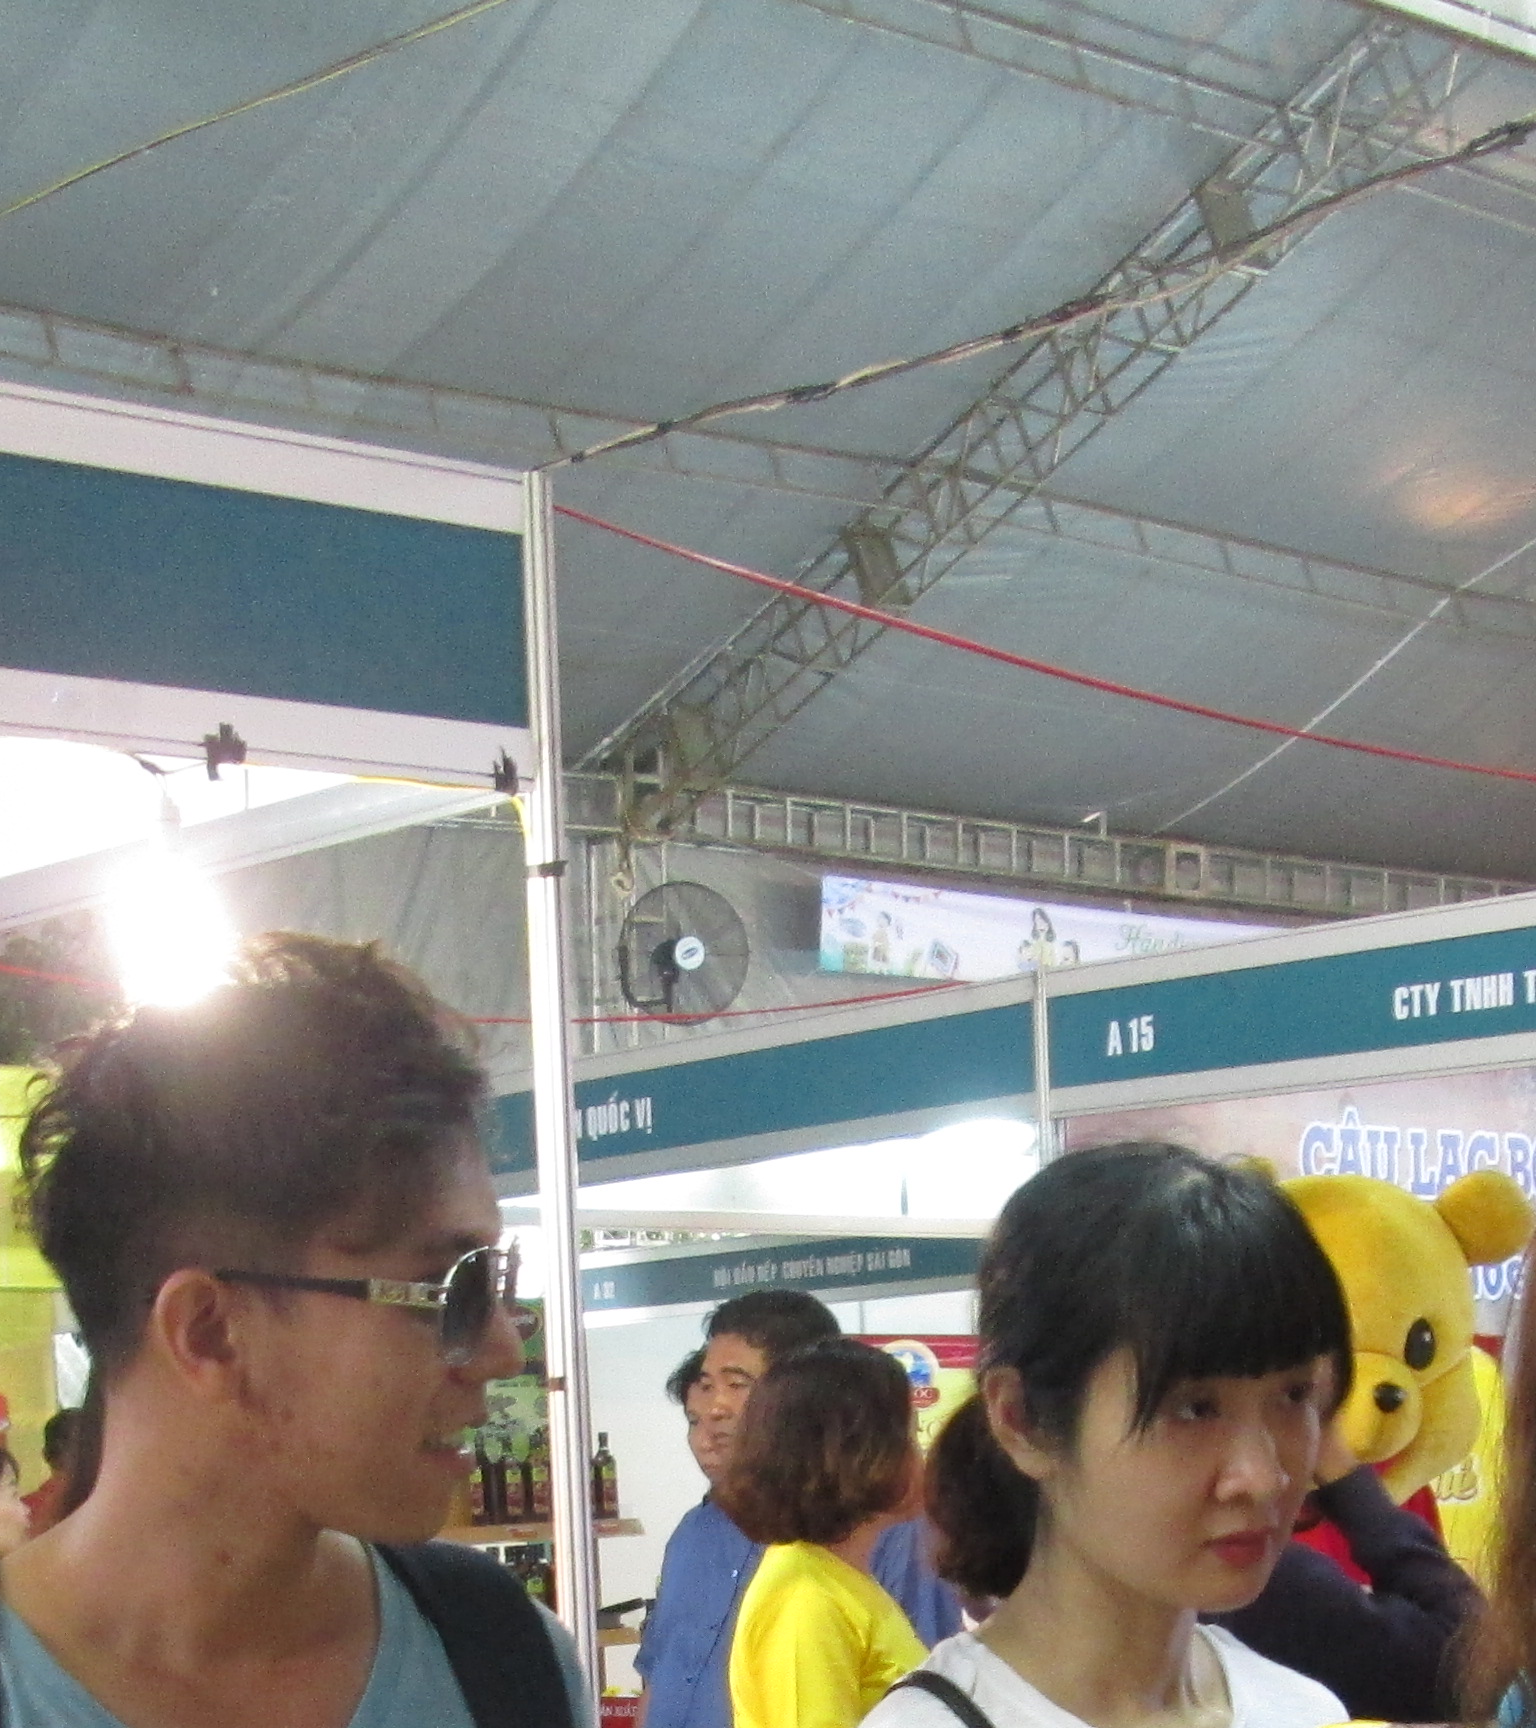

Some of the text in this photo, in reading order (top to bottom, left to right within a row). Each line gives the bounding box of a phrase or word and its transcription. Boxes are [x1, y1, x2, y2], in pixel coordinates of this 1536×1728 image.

[1393, 980, 1440, 1021] CTY
[1450, 972, 1514, 1014] TNHH
[1107, 1015, 1155, 1056] A 15
[587, 1091, 653, 1141] QUỐC VỊ
